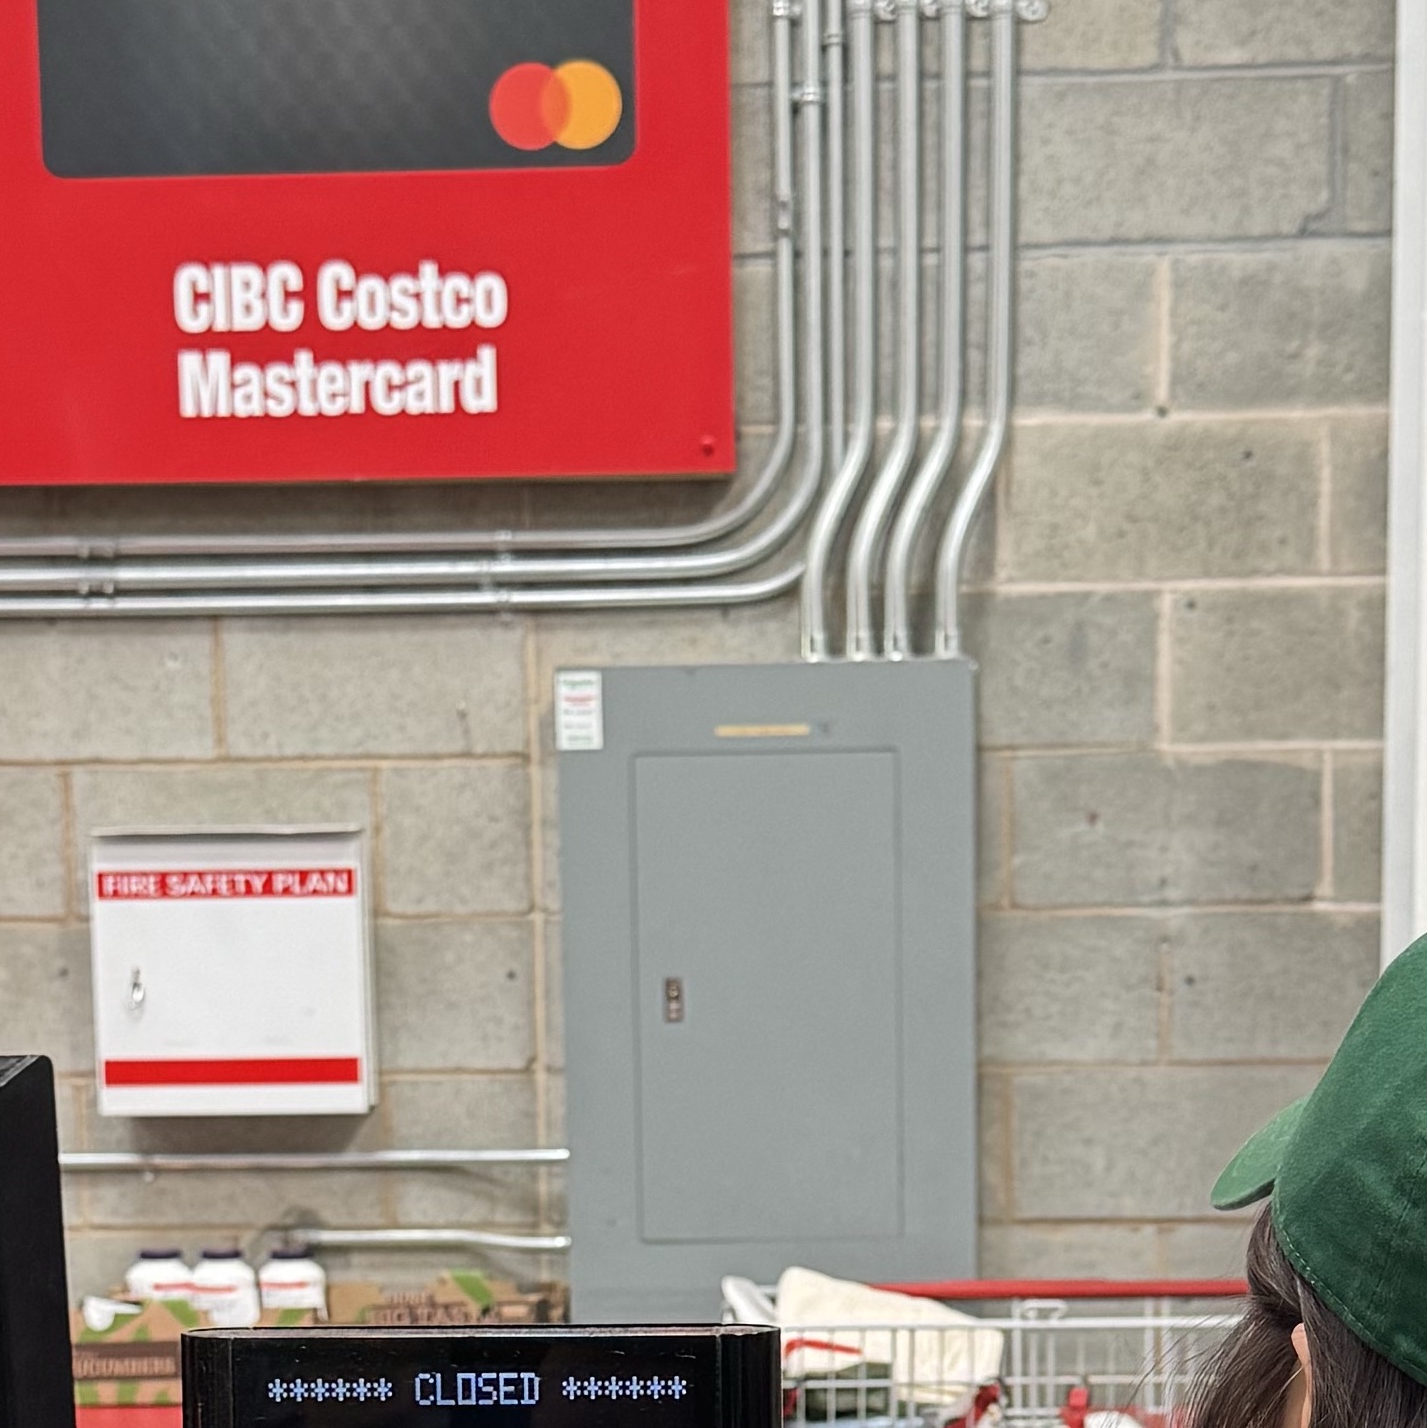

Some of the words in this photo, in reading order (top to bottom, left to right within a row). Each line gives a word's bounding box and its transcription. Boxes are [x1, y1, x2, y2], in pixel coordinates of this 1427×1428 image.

[173, 260, 305, 334] CIBC
[316, 258, 509, 331] Costco
[177, 343, 499, 418] Mastercard
[103, 874, 159, 897] FIRE
[166, 873, 269, 897] SAFETY
[272, 872, 350, 895] PLAN
[414, 1372, 541, 1406] CLOSED
